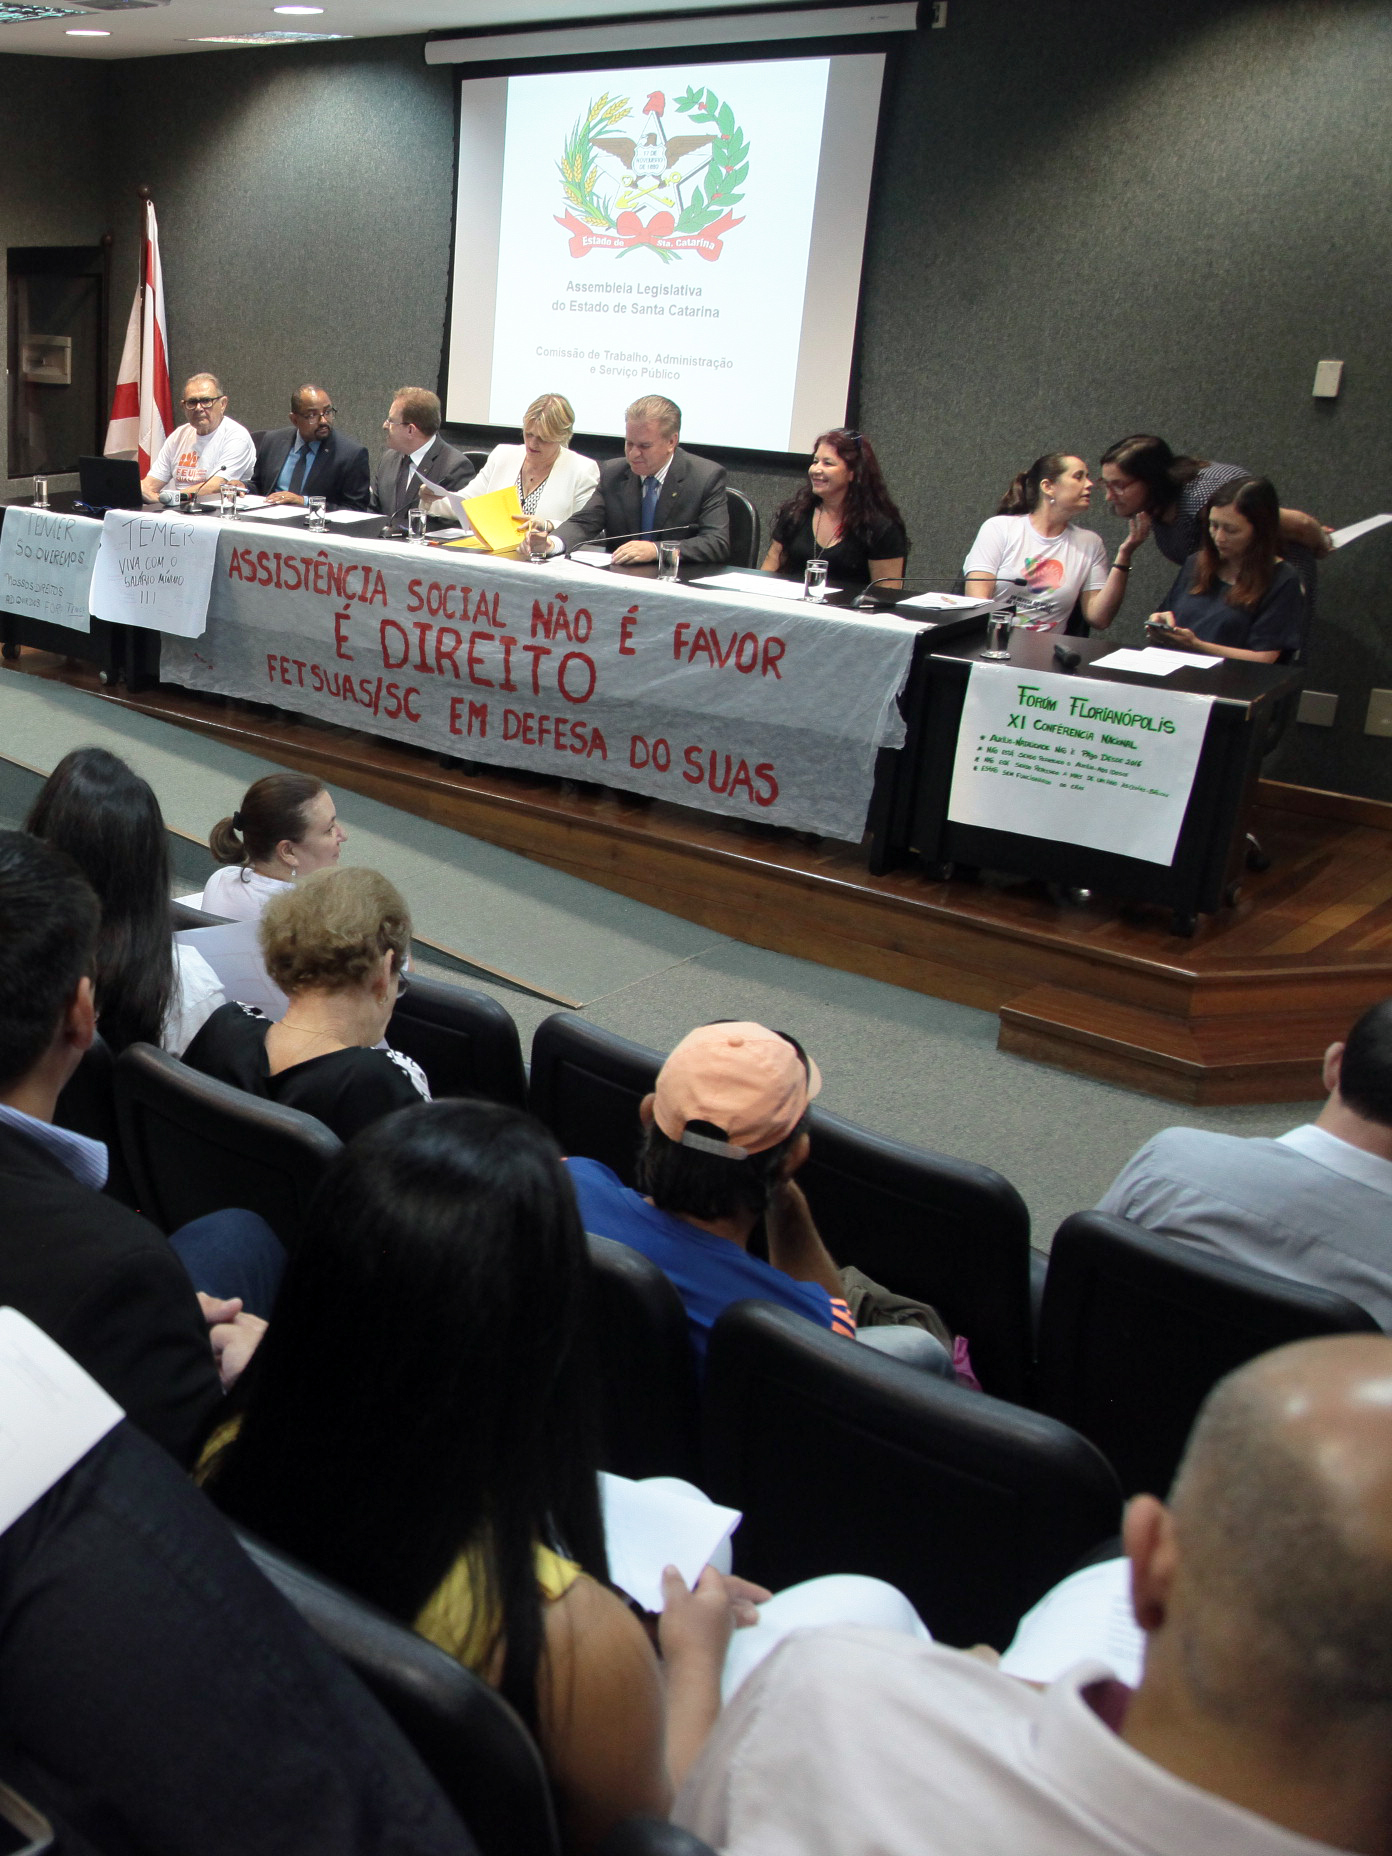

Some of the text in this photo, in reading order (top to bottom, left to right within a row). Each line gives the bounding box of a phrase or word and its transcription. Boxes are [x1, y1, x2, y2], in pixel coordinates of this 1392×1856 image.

[582, 236, 624, 247] Estado de
[656, 238, 716, 250] Sta. Catarina
[566, 280, 702, 298] Assembleia Legislativa
[551, 300, 720, 318] do Estado de Santa Catarina
[536, 346, 734, 370] Comissão de Trabalho, Administração
[590, 364, 680, 380] e Serviço Público
[28, 513, 76, 542] TEMER
[122, 516, 194, 551] TEMER
[118, 556, 178, 575] VIVA COM O
[124, 571, 156, 588] SALÁRIO
[228, 546, 786, 680] ASSISTÊNCIA SOCIAL NÃO É FAVOR
[334, 602, 596, 704] É DIREITO
[1006, 713, 1026, 730] XI
[449, 696, 488, 738] EM
[502, 708, 608, 760] DEFESA
[629, 735, 671, 772] DO
[682, 746, 779, 807] SUAS
